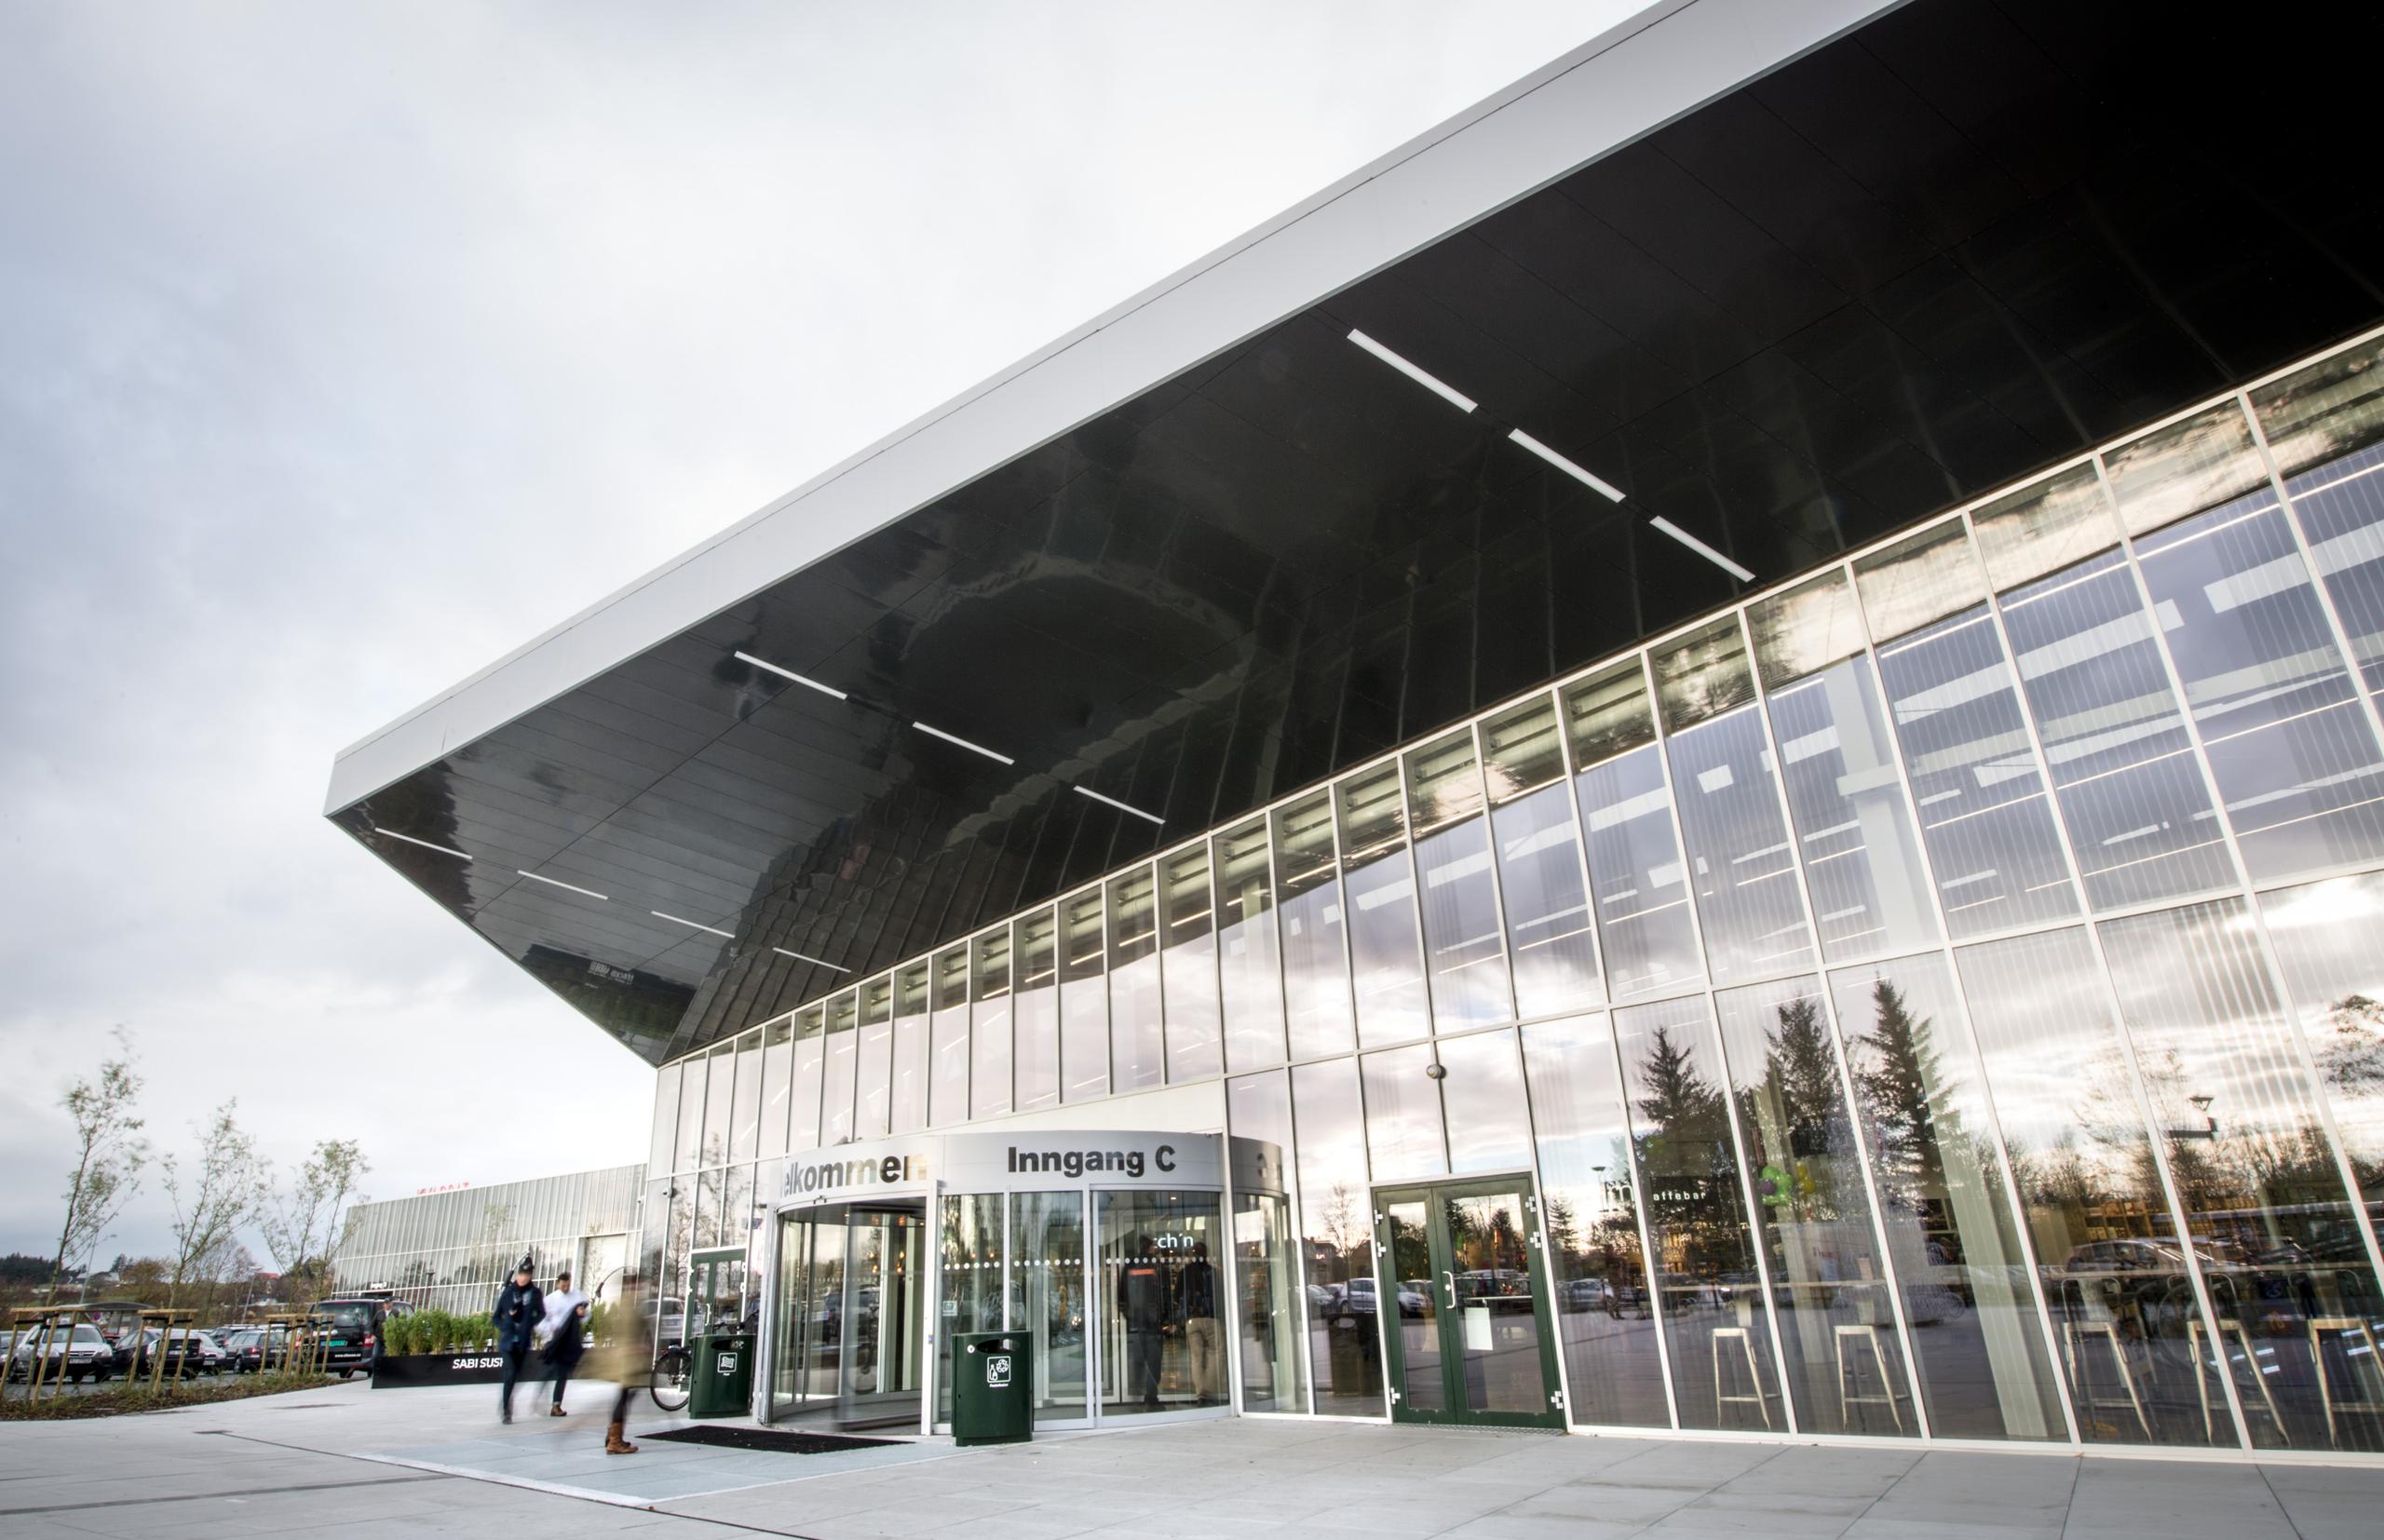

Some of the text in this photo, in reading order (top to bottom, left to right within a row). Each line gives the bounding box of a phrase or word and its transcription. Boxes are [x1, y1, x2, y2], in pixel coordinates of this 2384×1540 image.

[1008, 1145, 1176, 1178] Inngang C
[780, 1155, 928, 1198] elkommen
[1652, 1191, 1706, 1201] affebar
[452, 1358, 479, 1370] SABI
